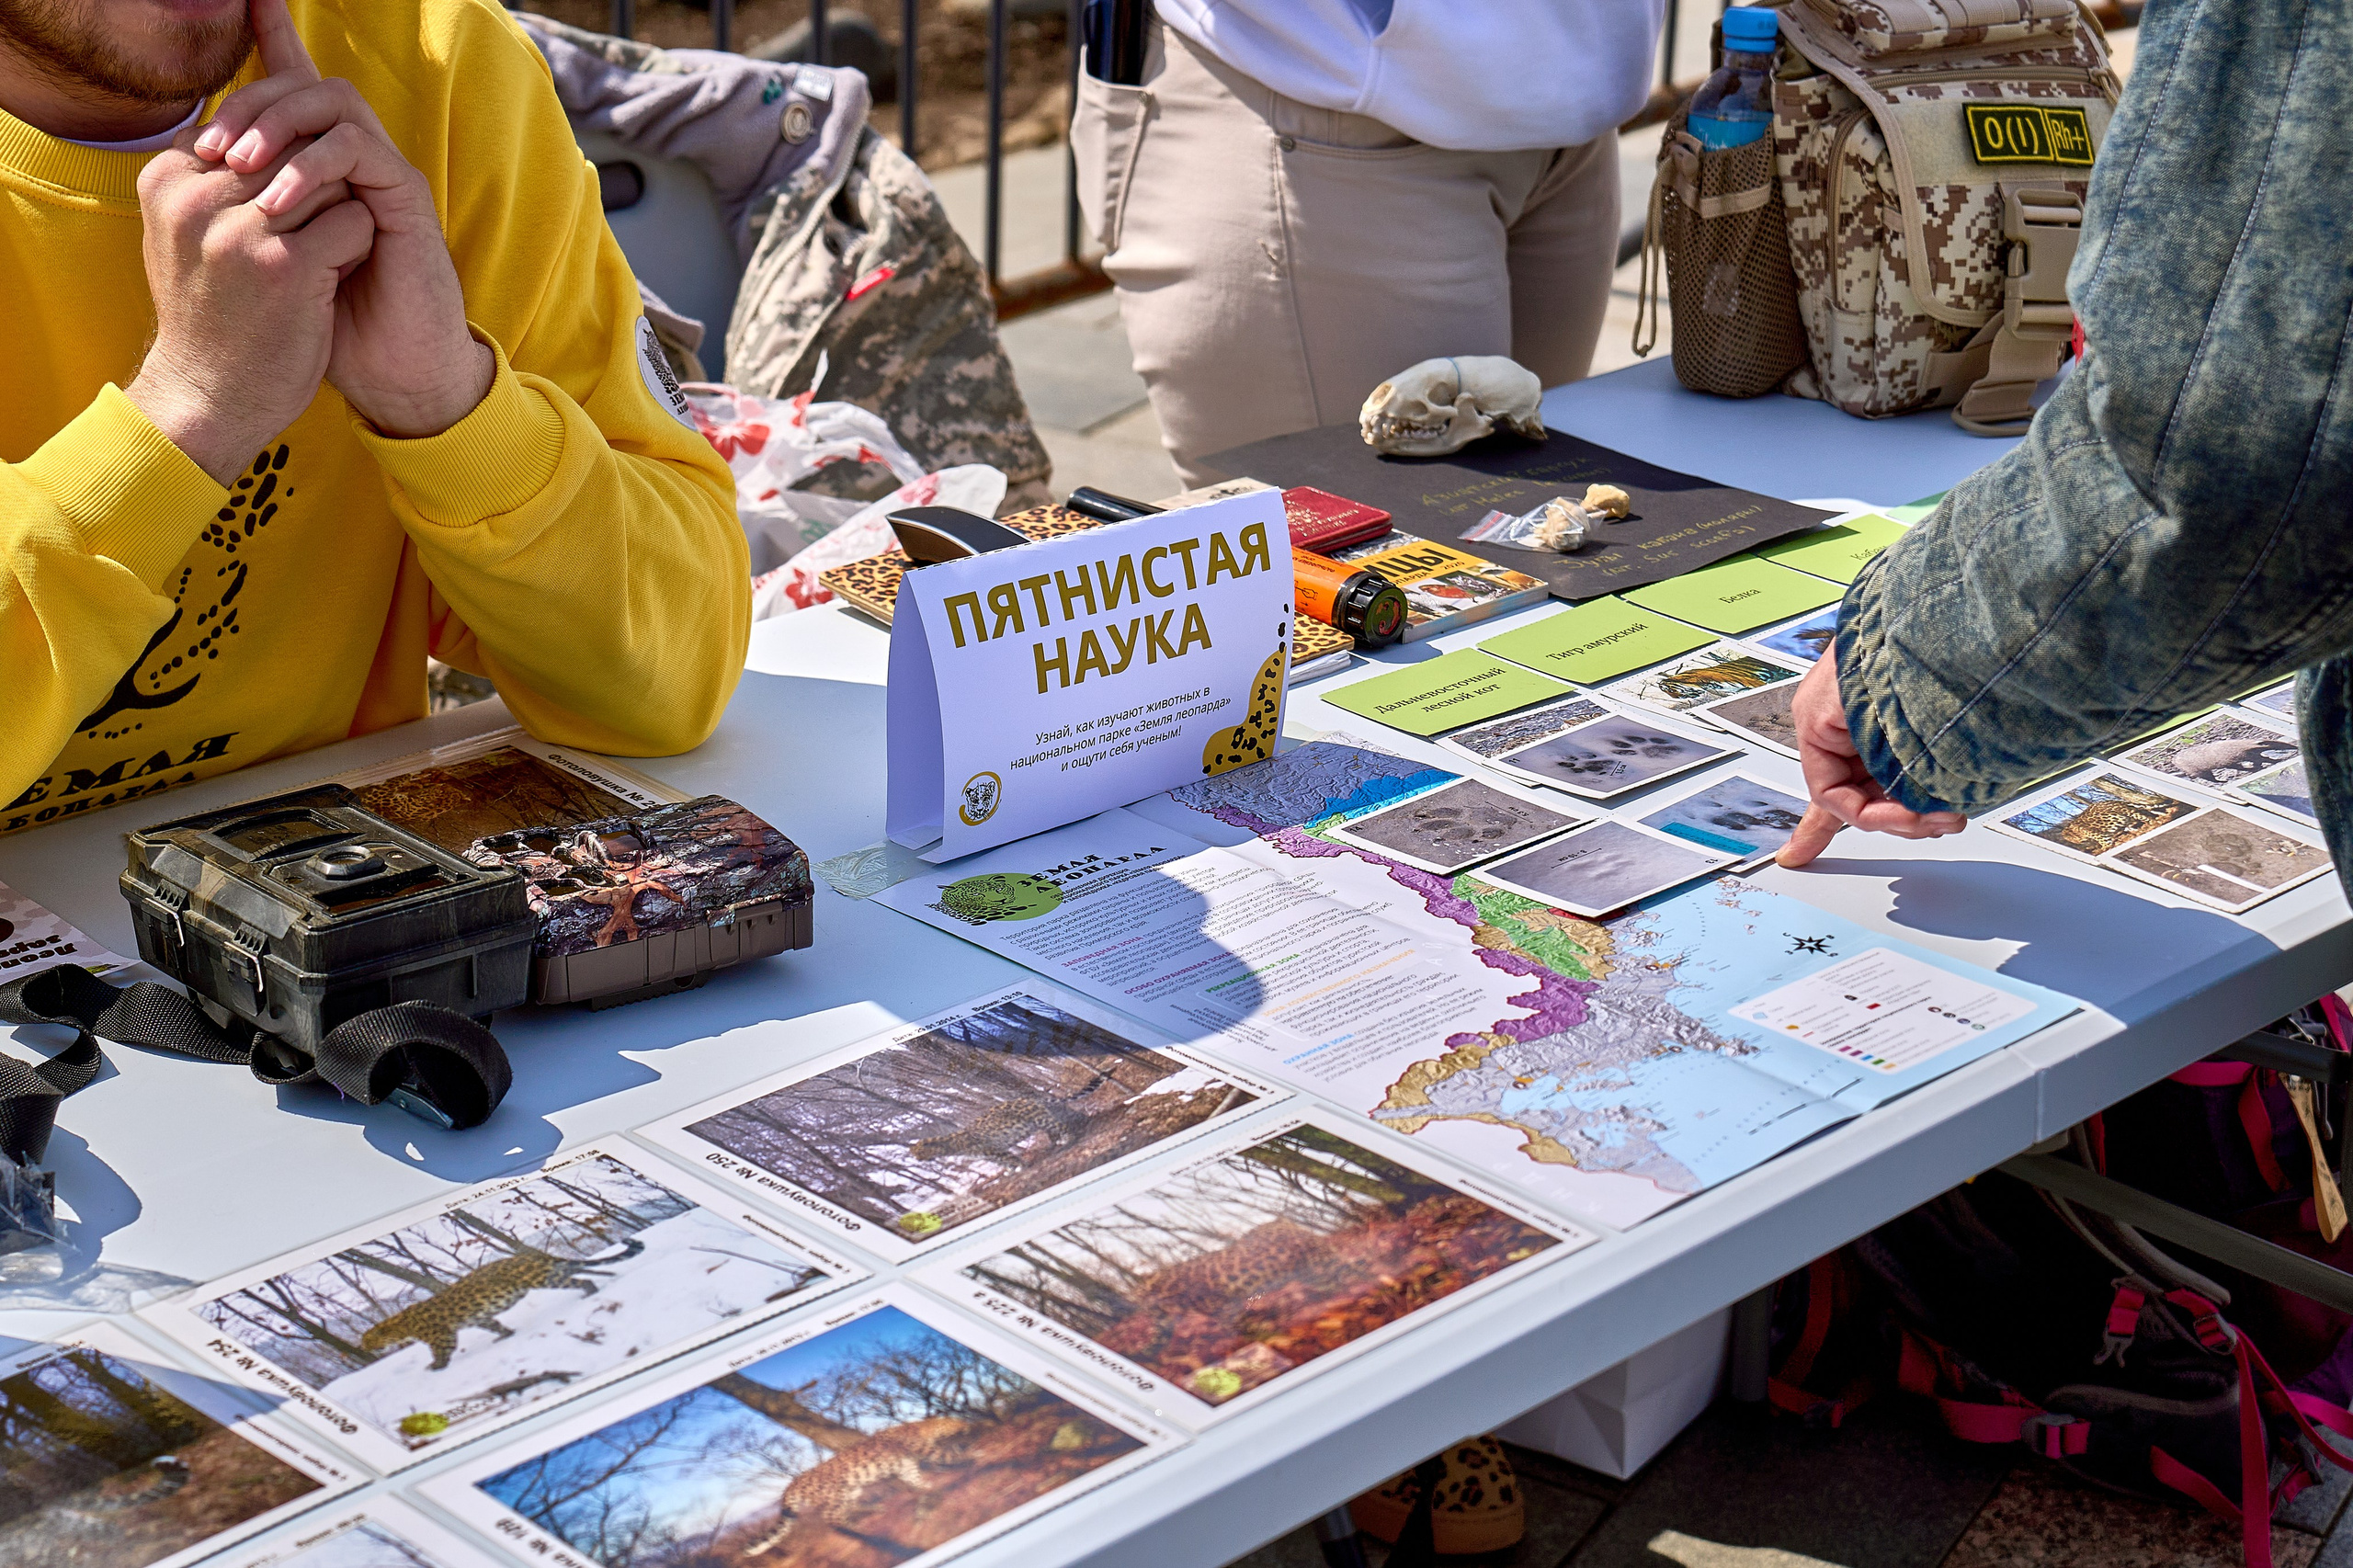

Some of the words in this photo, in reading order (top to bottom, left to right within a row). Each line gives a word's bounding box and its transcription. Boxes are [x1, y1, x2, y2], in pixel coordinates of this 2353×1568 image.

[2053, 119, 2085, 152] Rh+
[944, 522, 1271, 649] ПЯТНИСТАЯ
[1718, 587, 1761, 606] Белка
[1032, 603, 1212, 695] НАУКА
[1545, 645, 1582, 662] Тигр
[1583, 622, 1648, 651] амурский
[1374, 666, 1506, 715] Дальневосточный
[1421, 688, 1473, 713] лесной
[1477, 683, 1501, 697] кот
[1010, 736, 1096, 770] национальном
[1098, 726, 1131, 744] парке
[1133, 715, 1173, 733] «Земля
[1175, 697, 1232, 722] леопарда»
[1036, 724, 1073, 745] Узнай,
[1076, 721, 1095, 734] как
[1097, 705, 1143, 729] изучают
[1145, 690, 1200, 714] животных
[1203, 687, 1211, 697] в
[1061, 762, 1069, 772] и
[1071, 749, 1107, 769] ощути
[1109, 740, 1134, 757] себя
[1136, 724, 1182, 751] ученым!
[0, 732, 240, 812] ЕМЛЯ
[548, 754, 628, 793] Фотоловушка
[626, 791, 644, 802] №
[1017, 854, 1104, 887] ЗЕМЛЯ
[1036, 846, 1167, 894] ЛЕОПАРДА
[1001, 922, 1047, 942] Территория
[1045, 913, 1070, 926] парка
[1069, 899, 1108, 916] разделена
[1016, 923, 1063, 943] различными
[1062, 908, 1103, 926] режимами
[1101, 897, 1131, 911] охраны
[1049, 931, 1080, 945] система
[0, 942, 77, 969] Леоп
[1046, 945, 1080, 960] развития
[1079, 926, 1130, 949] Приморского
[1062, 944, 1118, 968] ЗАПОВЕДНАЯ
[1118, 935, 1142, 947] ЗОНА
[1124, 981, 1154, 994] ОСОБО
[1154, 960, 1209, 983] ОХРАНЯЕМАЯ
[1208, 950, 1233, 962] ЗОНА
[1206, 962, 1278, 994] РЕКРЕАЦИОННАЯ
[1276, 952, 1301, 964] ЗОНА
[705, 1152, 738, 1171] 250
[736, 1166, 757, 1181] №
[758, 1175, 861, 1232] Фотоловушка
[1017, 1316, 1037, 1330] №
[206, 1338, 235, 1359] 254
[236, 1356, 257, 1372] №
[1040, 1325, 1154, 1392] Фотоловушка
[256, 1369, 358, 1436] Фотоловушка
